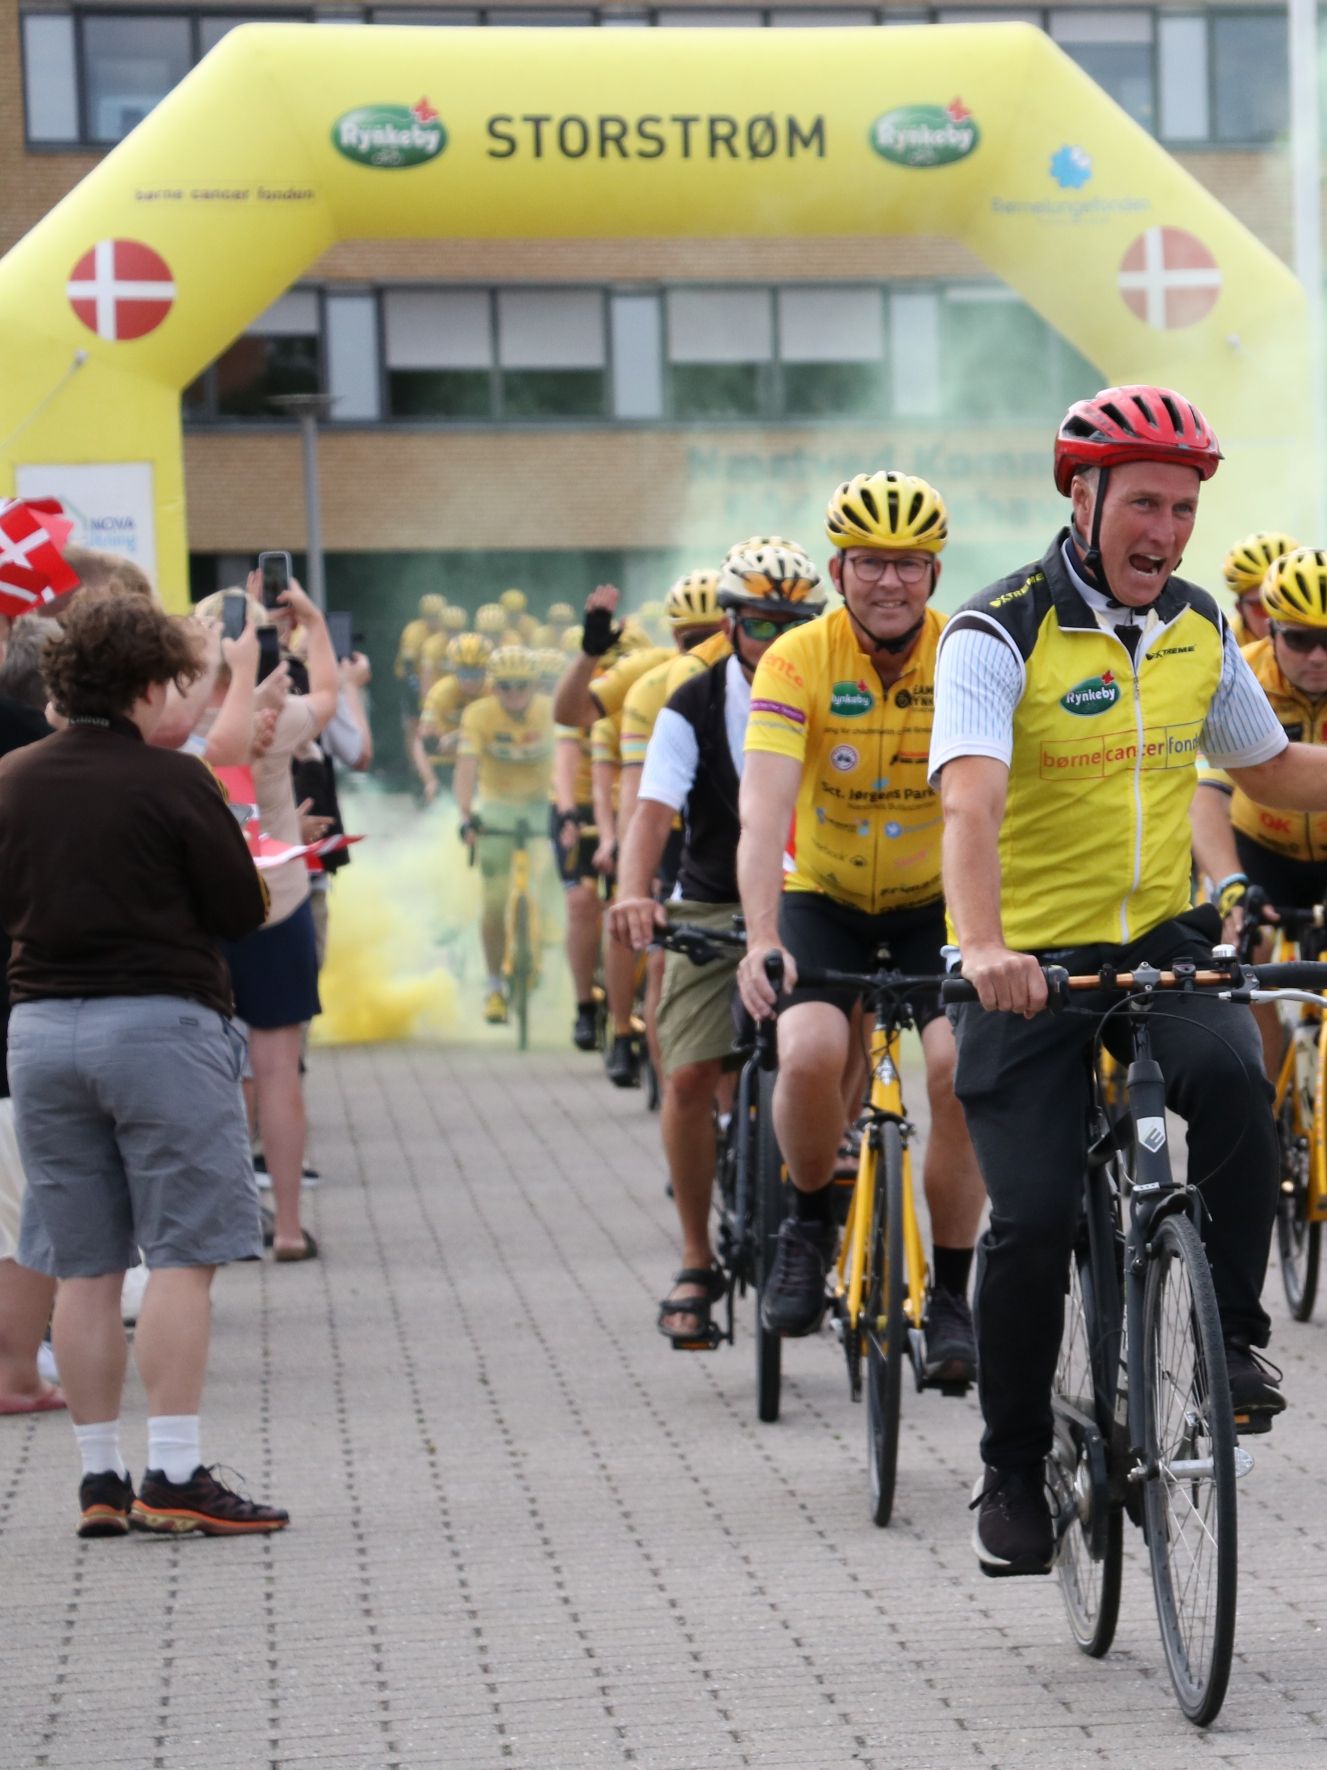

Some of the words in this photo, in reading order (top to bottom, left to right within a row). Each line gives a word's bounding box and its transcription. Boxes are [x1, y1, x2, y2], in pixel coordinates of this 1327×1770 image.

[338, 119, 441, 151] Rynkeby
[486, 112, 827, 161] STORSTRØM
[876, 118, 975, 150] Rynkeby
[190, 187, 250, 201] cancer
[90, 515, 134, 531] NOVA
[832, 693, 870, 707] ynkeby
[1066, 685, 1116, 706] Rynkeby
[1042, 750, 1101, 769] børne
[1103, 742, 1165, 762] caner
[1167, 733, 1200, 754] fond
[821, 780, 845, 799] Sct.
[849, 787, 900, 803] Jørgens
